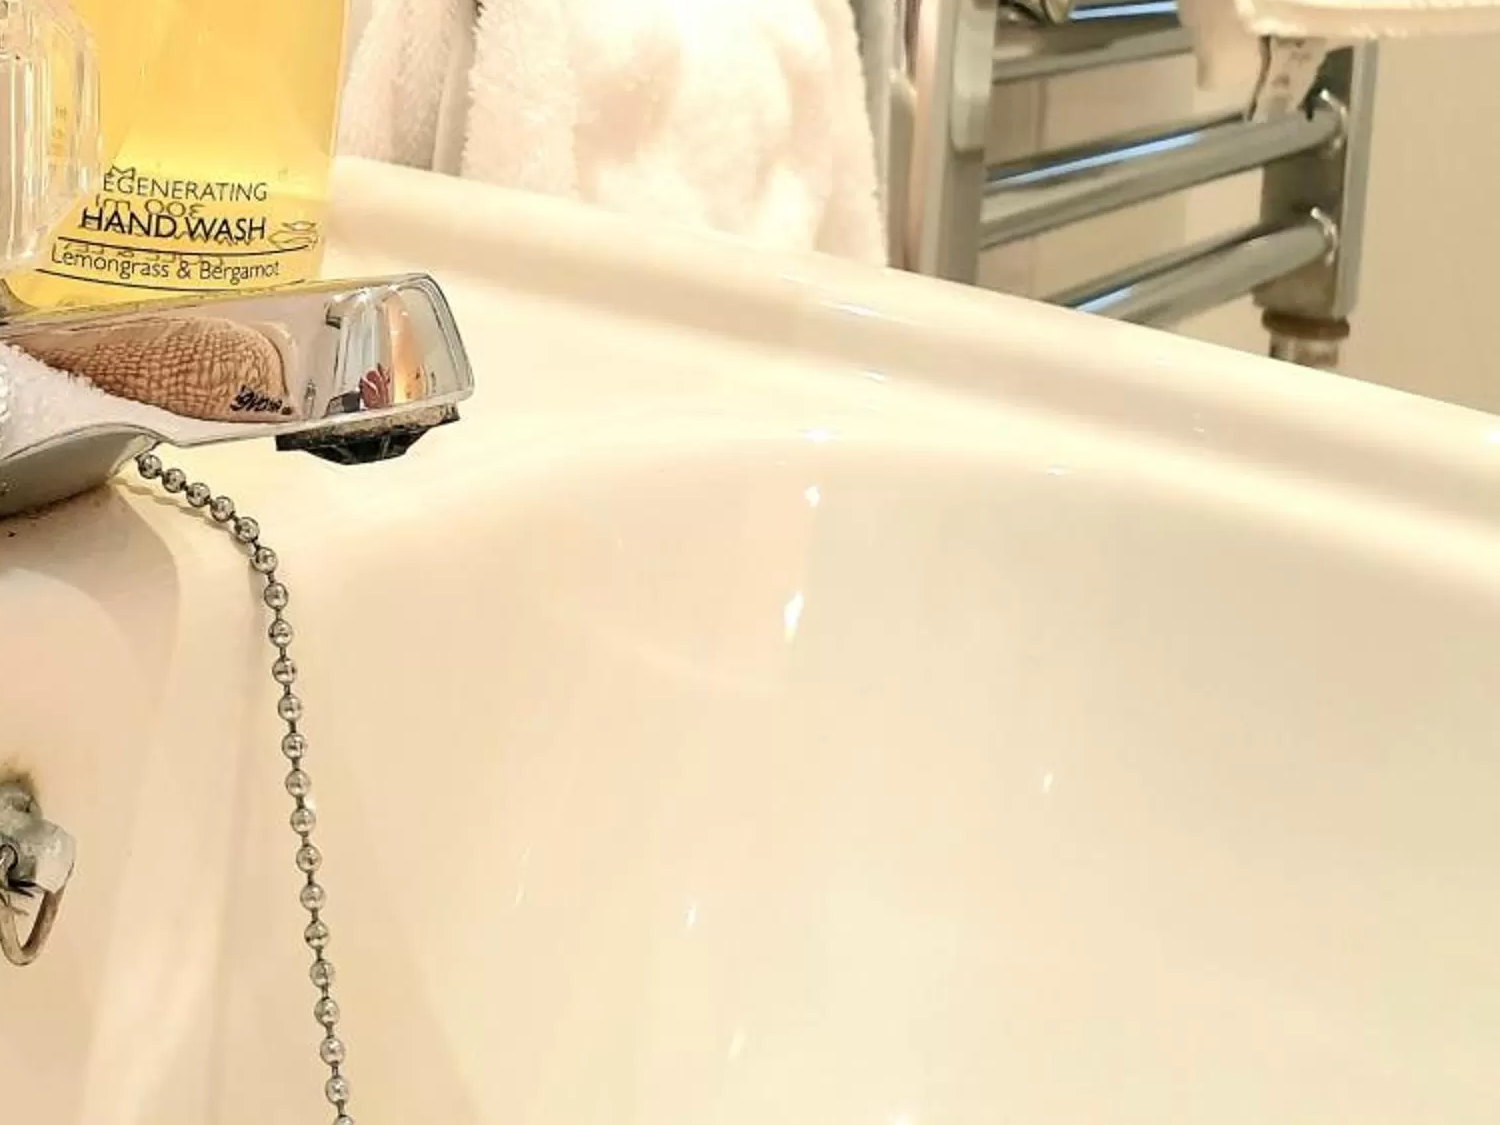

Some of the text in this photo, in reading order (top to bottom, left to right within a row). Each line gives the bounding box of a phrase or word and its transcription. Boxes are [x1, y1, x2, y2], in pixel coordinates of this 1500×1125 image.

[102, 174, 267, 202] EGENERATING
[80, 205, 266, 243] HAND WASH
[51, 242, 279, 285] Lemongrass & Bergamot
